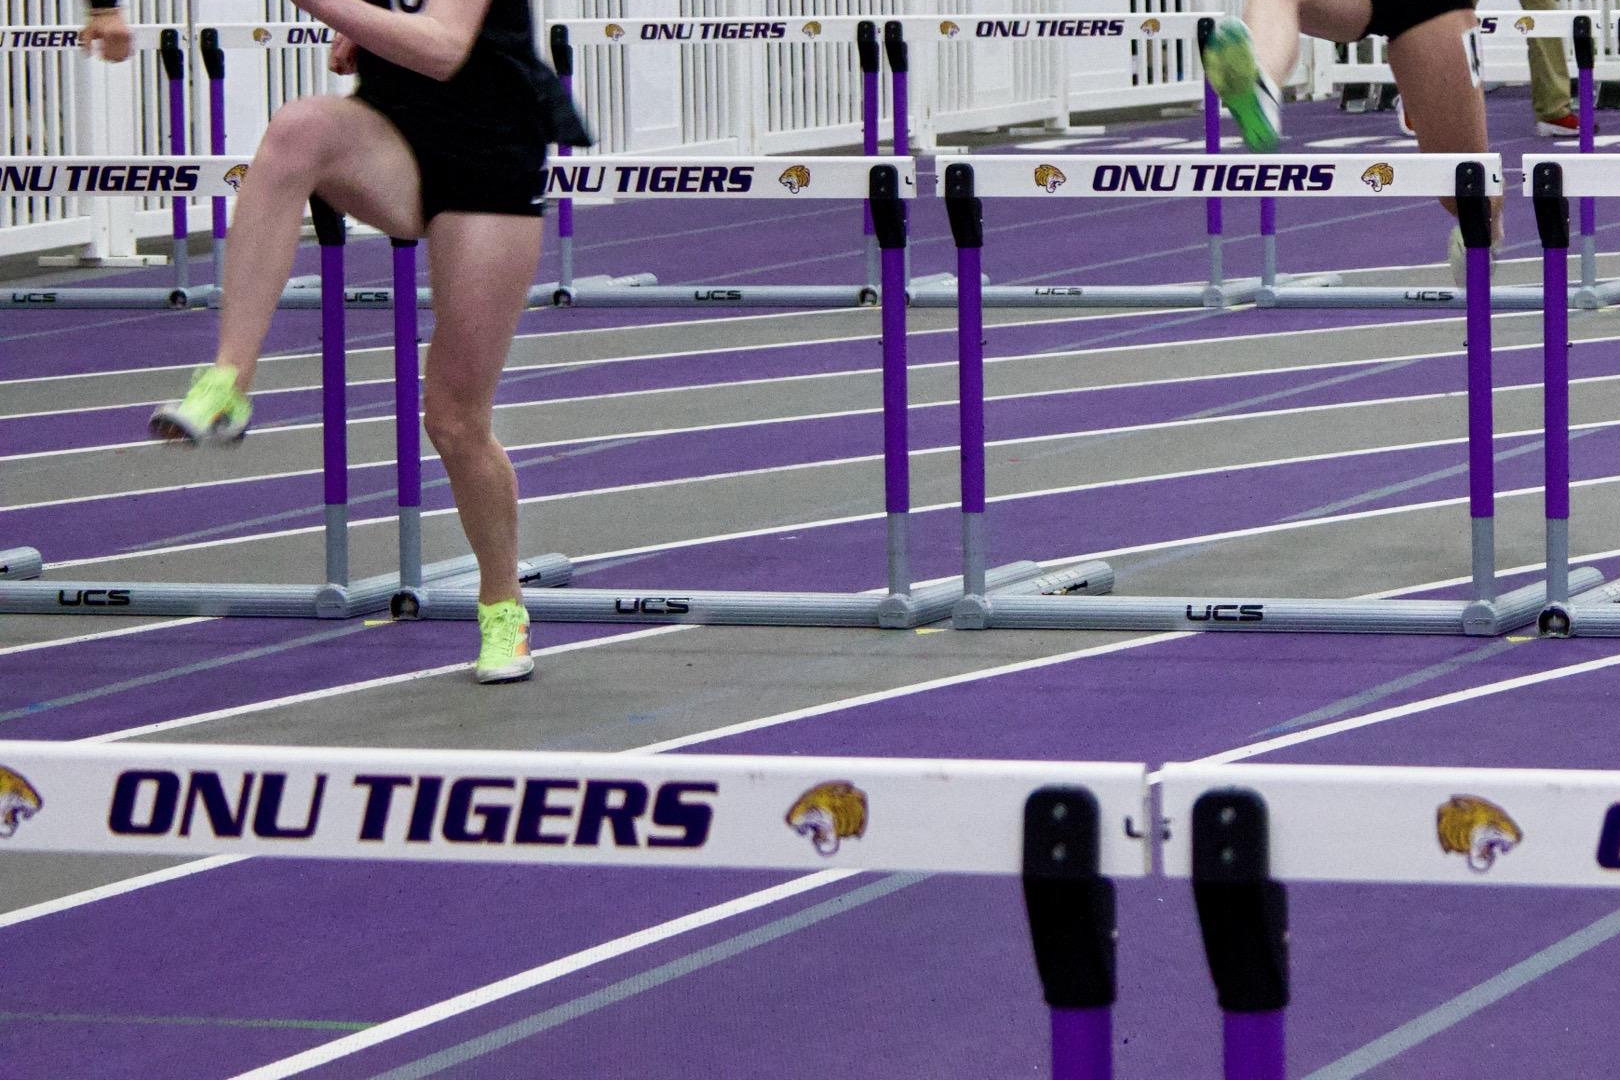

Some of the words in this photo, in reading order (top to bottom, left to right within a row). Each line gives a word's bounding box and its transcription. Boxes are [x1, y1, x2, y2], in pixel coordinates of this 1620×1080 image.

[640, 23, 693, 40] ONU
[699, 22, 787, 39] TIGERS
[976, 20, 1029, 38] ONU
[1036, 18, 1125, 36] TIGERS
[0, 166, 57, 192] NU
[66, 165, 200, 192] TIGERS
[547, 166, 605, 192] NU
[614, 166, 754, 193] TIGERS
[1092, 164, 1180, 192] ONU
[1191, 163, 1336, 192] TIGERS
[12, 293, 57, 303] UCS
[344, 292, 389, 303] UCS
[695, 290, 742, 301] UCS
[1034, 287, 1083, 296] UCS
[1403, 290, 1454, 301] UCS
[57, 589, 131, 607] UCS
[614, 597, 691, 615] UCS
[1185, 603, 1264, 622] UCS
[108, 768, 328, 838] ONU
[352, 773, 719, 849] TIGERS
